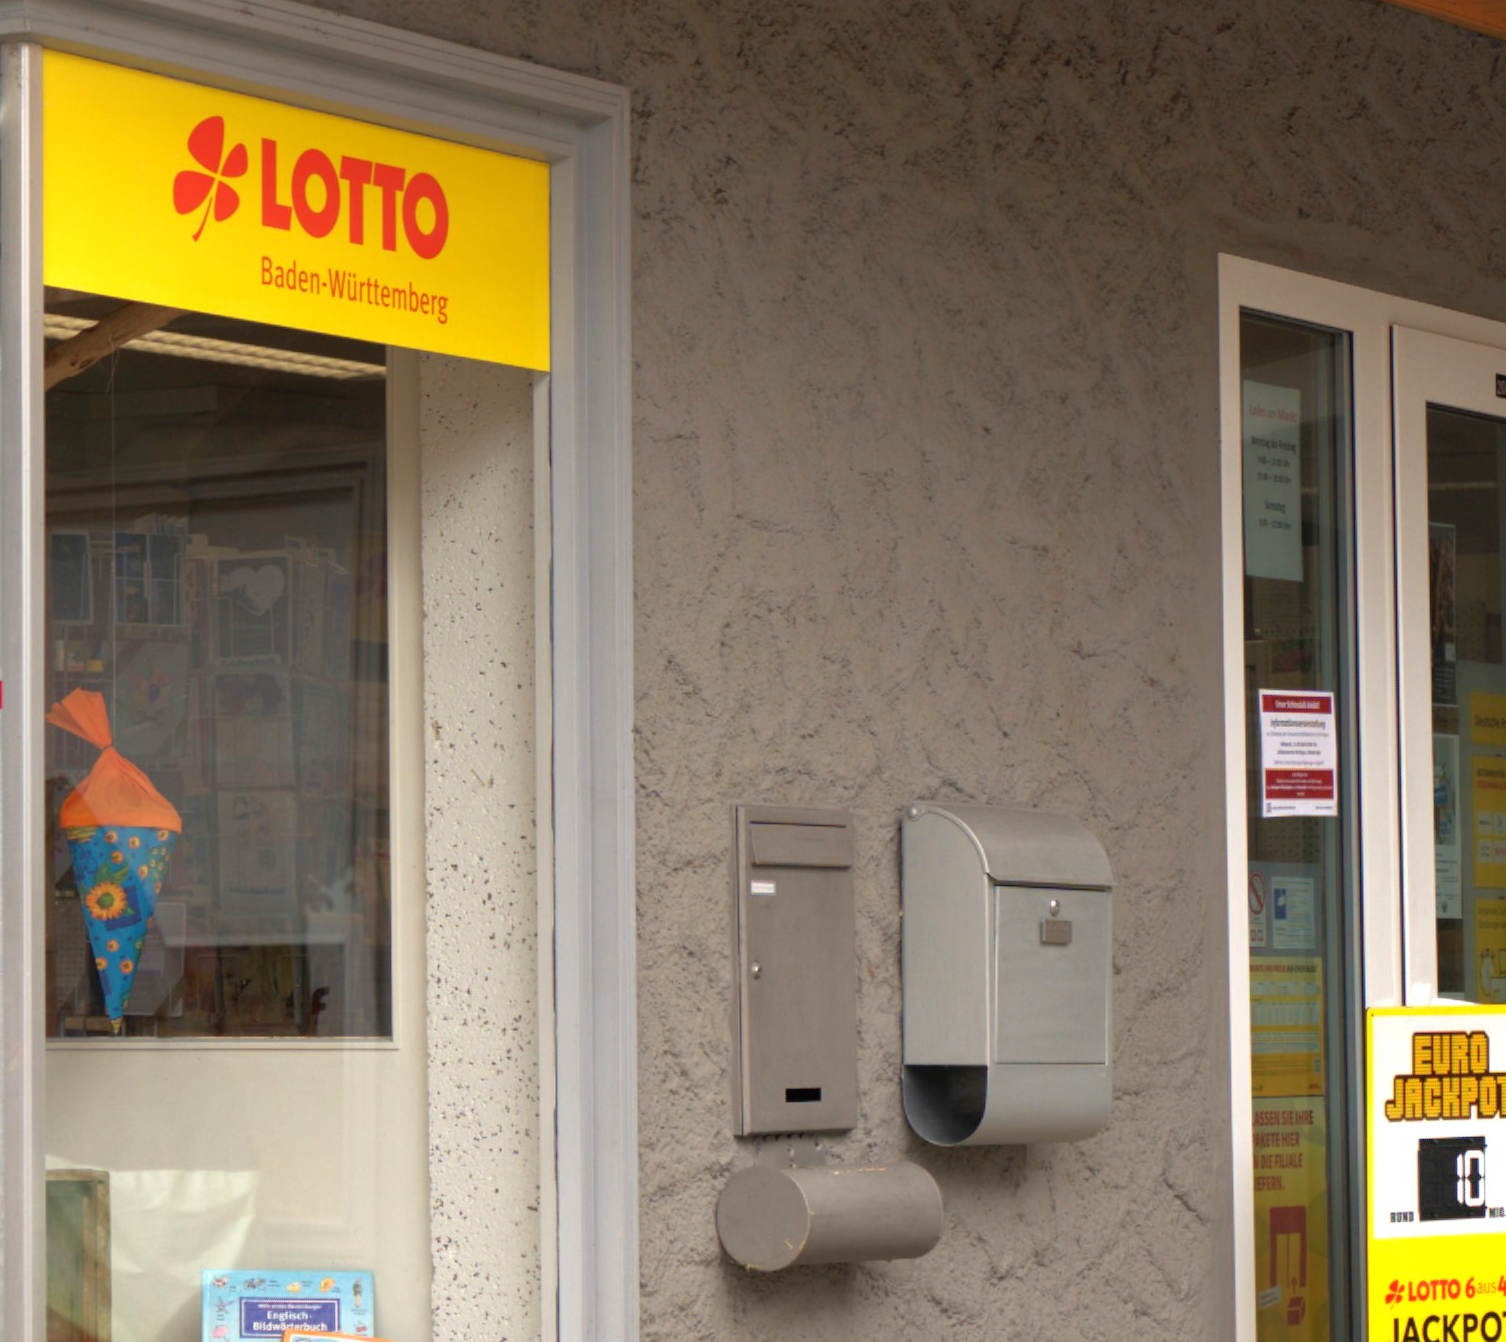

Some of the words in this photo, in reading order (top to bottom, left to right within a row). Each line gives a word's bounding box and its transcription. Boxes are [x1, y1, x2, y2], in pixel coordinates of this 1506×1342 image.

[260, 138, 450, 261] LOTTO
[260, 254, 449, 325] Baden-Württemberg
[1412, 1031, 1489, 1076] EURO
[1281, 1110, 1294, 1126] SIE
[1295, 1109, 1314, 1125] IHRE
[1281, 1131, 1300, 1147] HIER
[1260, 1154, 1273, 1169] DIE
[1457, 1149, 1485, 1208] 10
[1390, 1211, 1415, 1223] RUND
[1408, 1278, 1461, 1302] LOTTO
